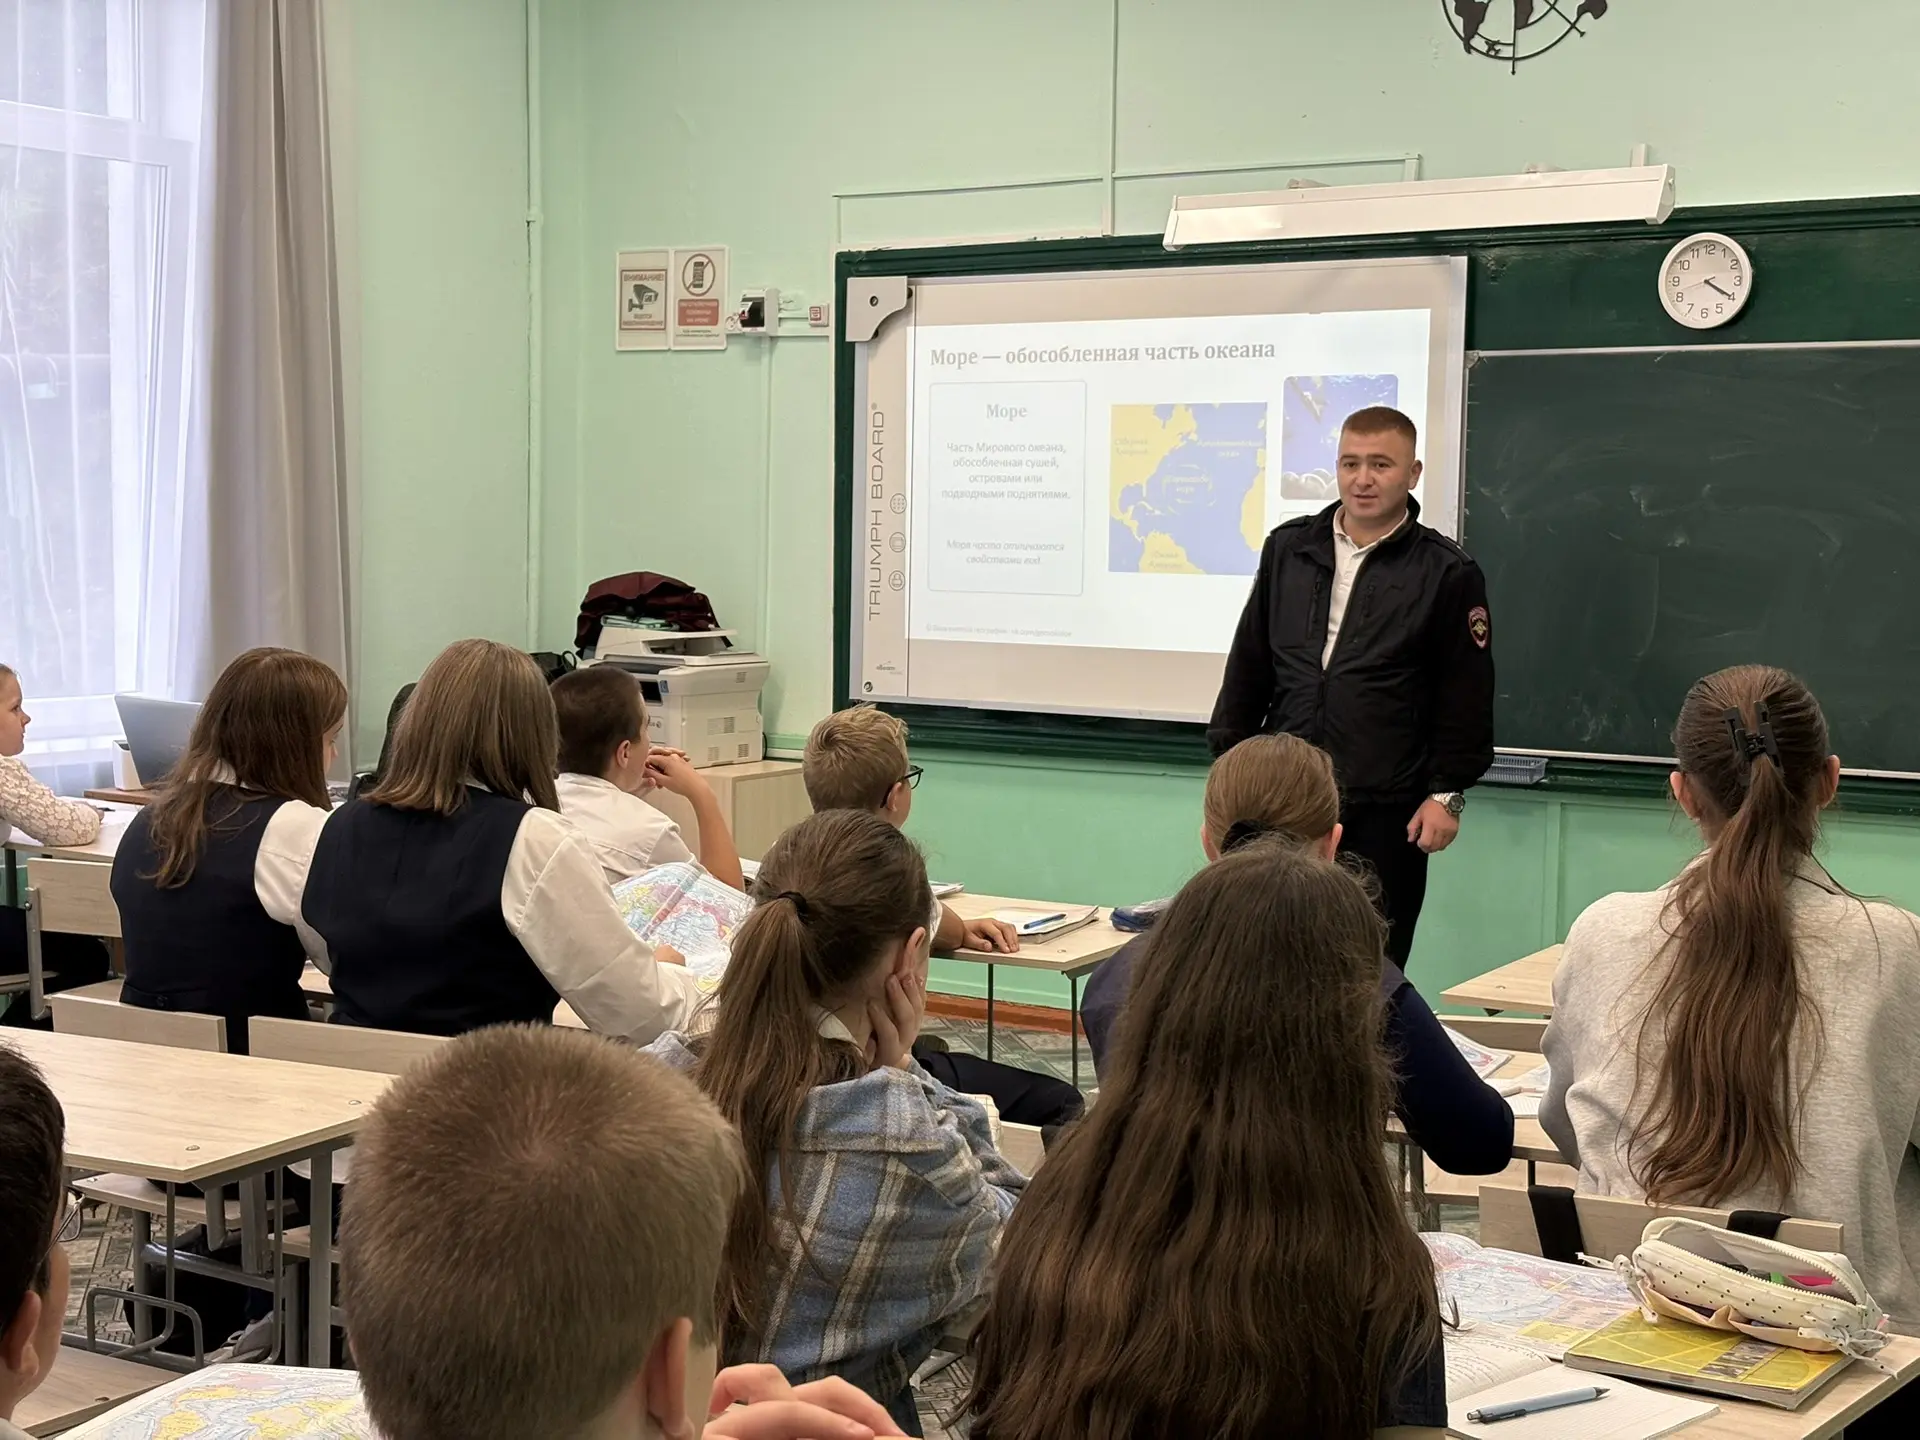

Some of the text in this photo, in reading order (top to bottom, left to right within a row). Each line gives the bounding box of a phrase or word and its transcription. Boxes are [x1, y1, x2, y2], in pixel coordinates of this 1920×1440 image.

[1690, 248, 1700, 259] 11
[1703, 244, 1716, 255] 12
[1678, 259, 1690, 270] 10
[1730, 259, 1739, 270] 2
[1672, 276, 1680, 287] 9
[1733, 275, 1742, 286] 3
[1676, 292, 1684, 303] 8
[1687, 303, 1694, 314] 7
[1700, 308, 1708, 319] 6
[1715, 303, 1723, 314] 5
[930, 349, 978, 370] Море
[1005, 345, 1139, 364] обособленная
[1144, 345, 1199, 360] часть
[1204, 342, 1275, 359] океана
[986, 403, 1028, 422] Море
[947, 442, 974, 453] Часть
[975, 442, 1026, 456] Мирового
[952, 456, 1023, 468] обособленная
[968, 473, 1043, 485] островами или
[868, 509, 883, 622] TRIUMPH
